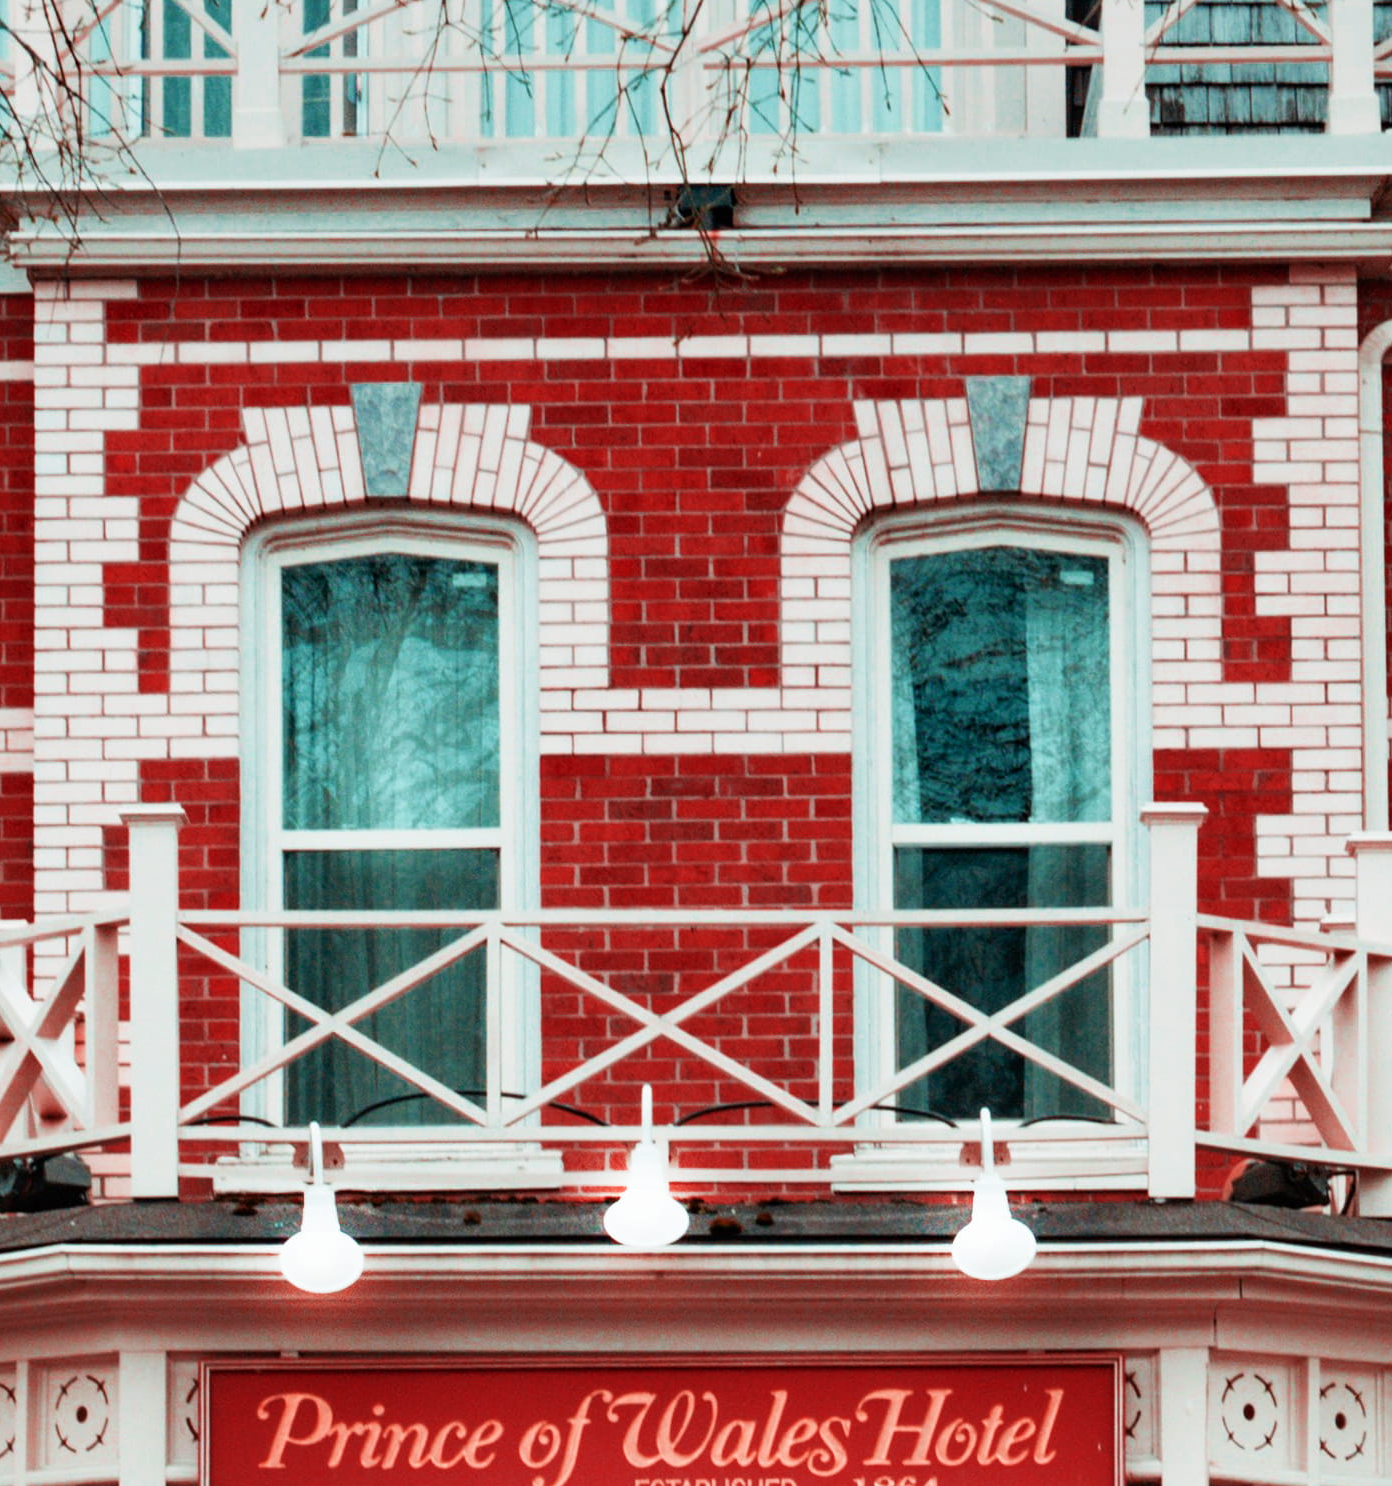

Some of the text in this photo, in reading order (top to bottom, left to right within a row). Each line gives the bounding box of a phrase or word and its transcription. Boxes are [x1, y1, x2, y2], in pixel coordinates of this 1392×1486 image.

[258, 1393, 505, 1470] Prince
[607, 1389, 852, 1478] Wales
[856, 1388, 1064, 1467] Hotel
